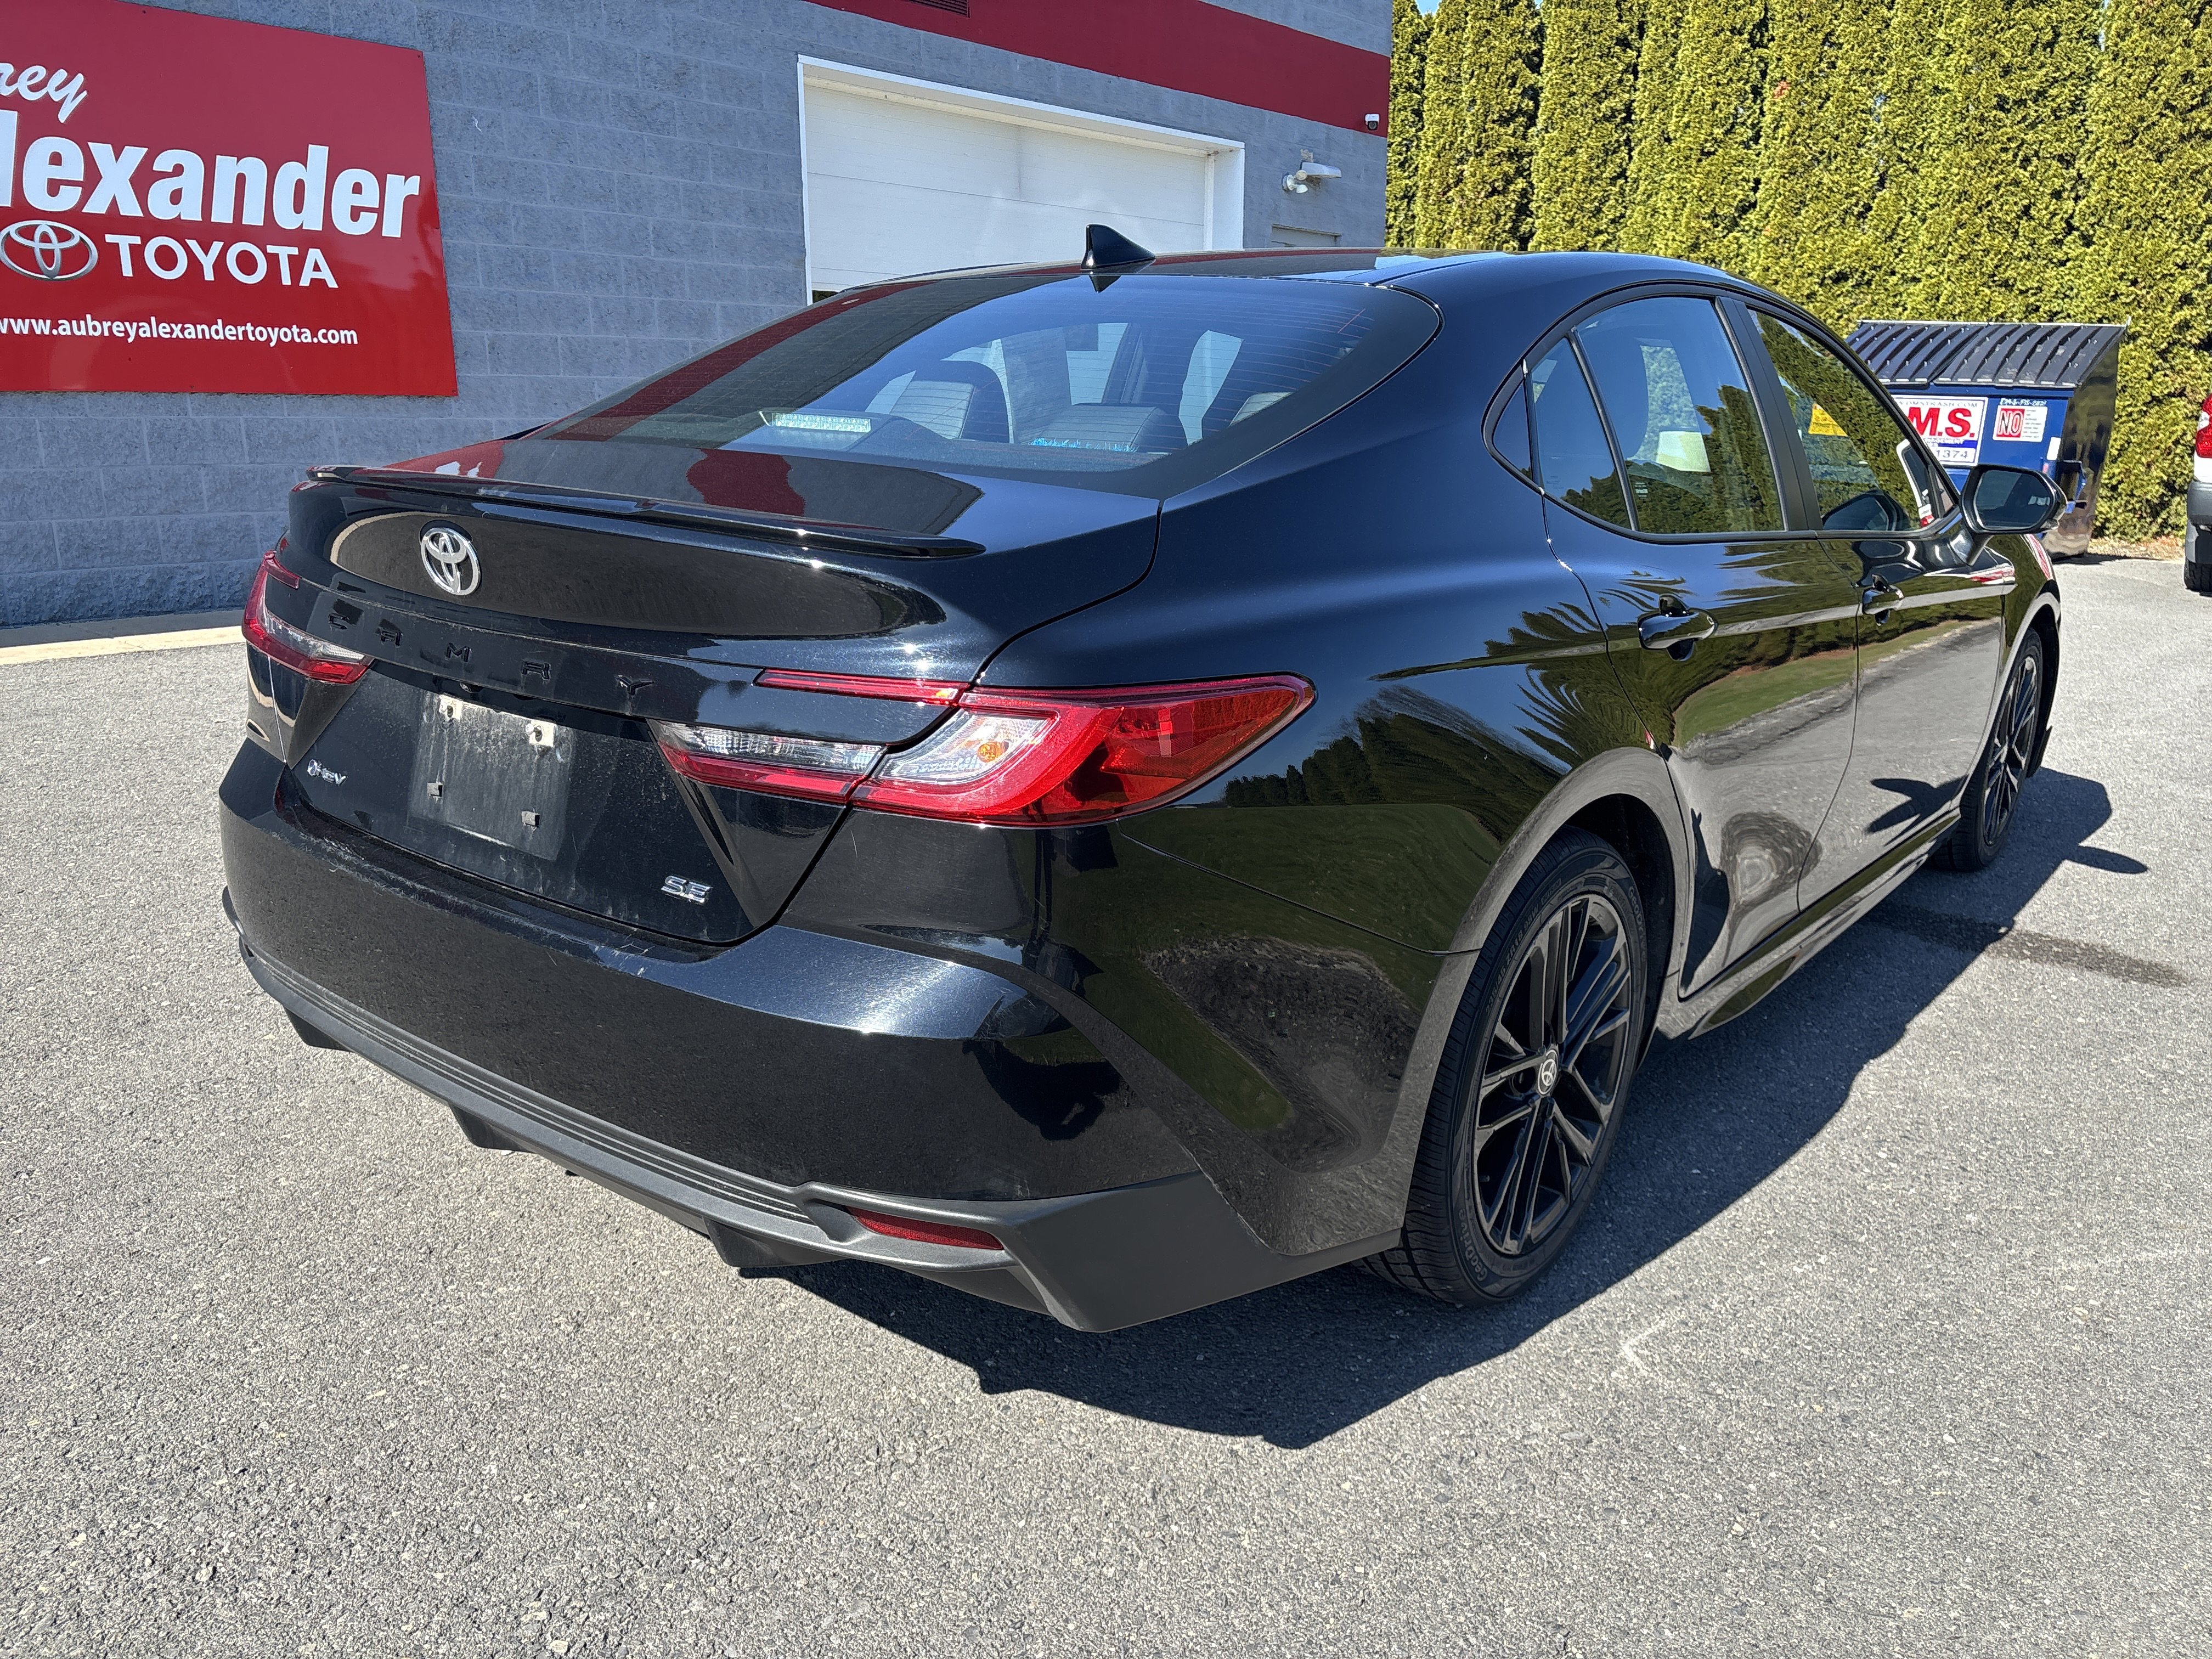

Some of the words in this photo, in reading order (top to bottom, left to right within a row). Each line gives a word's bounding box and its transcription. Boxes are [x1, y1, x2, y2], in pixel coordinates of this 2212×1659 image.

[105, 234, 339, 289] TOYOTA
[1997, 410, 2023, 436] NO
[1935, 449, 1968, 459] 1374
[328, 612, 654, 696] CAMRY
[661, 875, 712, 904] SE
[1458, 1208, 1488, 1282] GeoDrive
